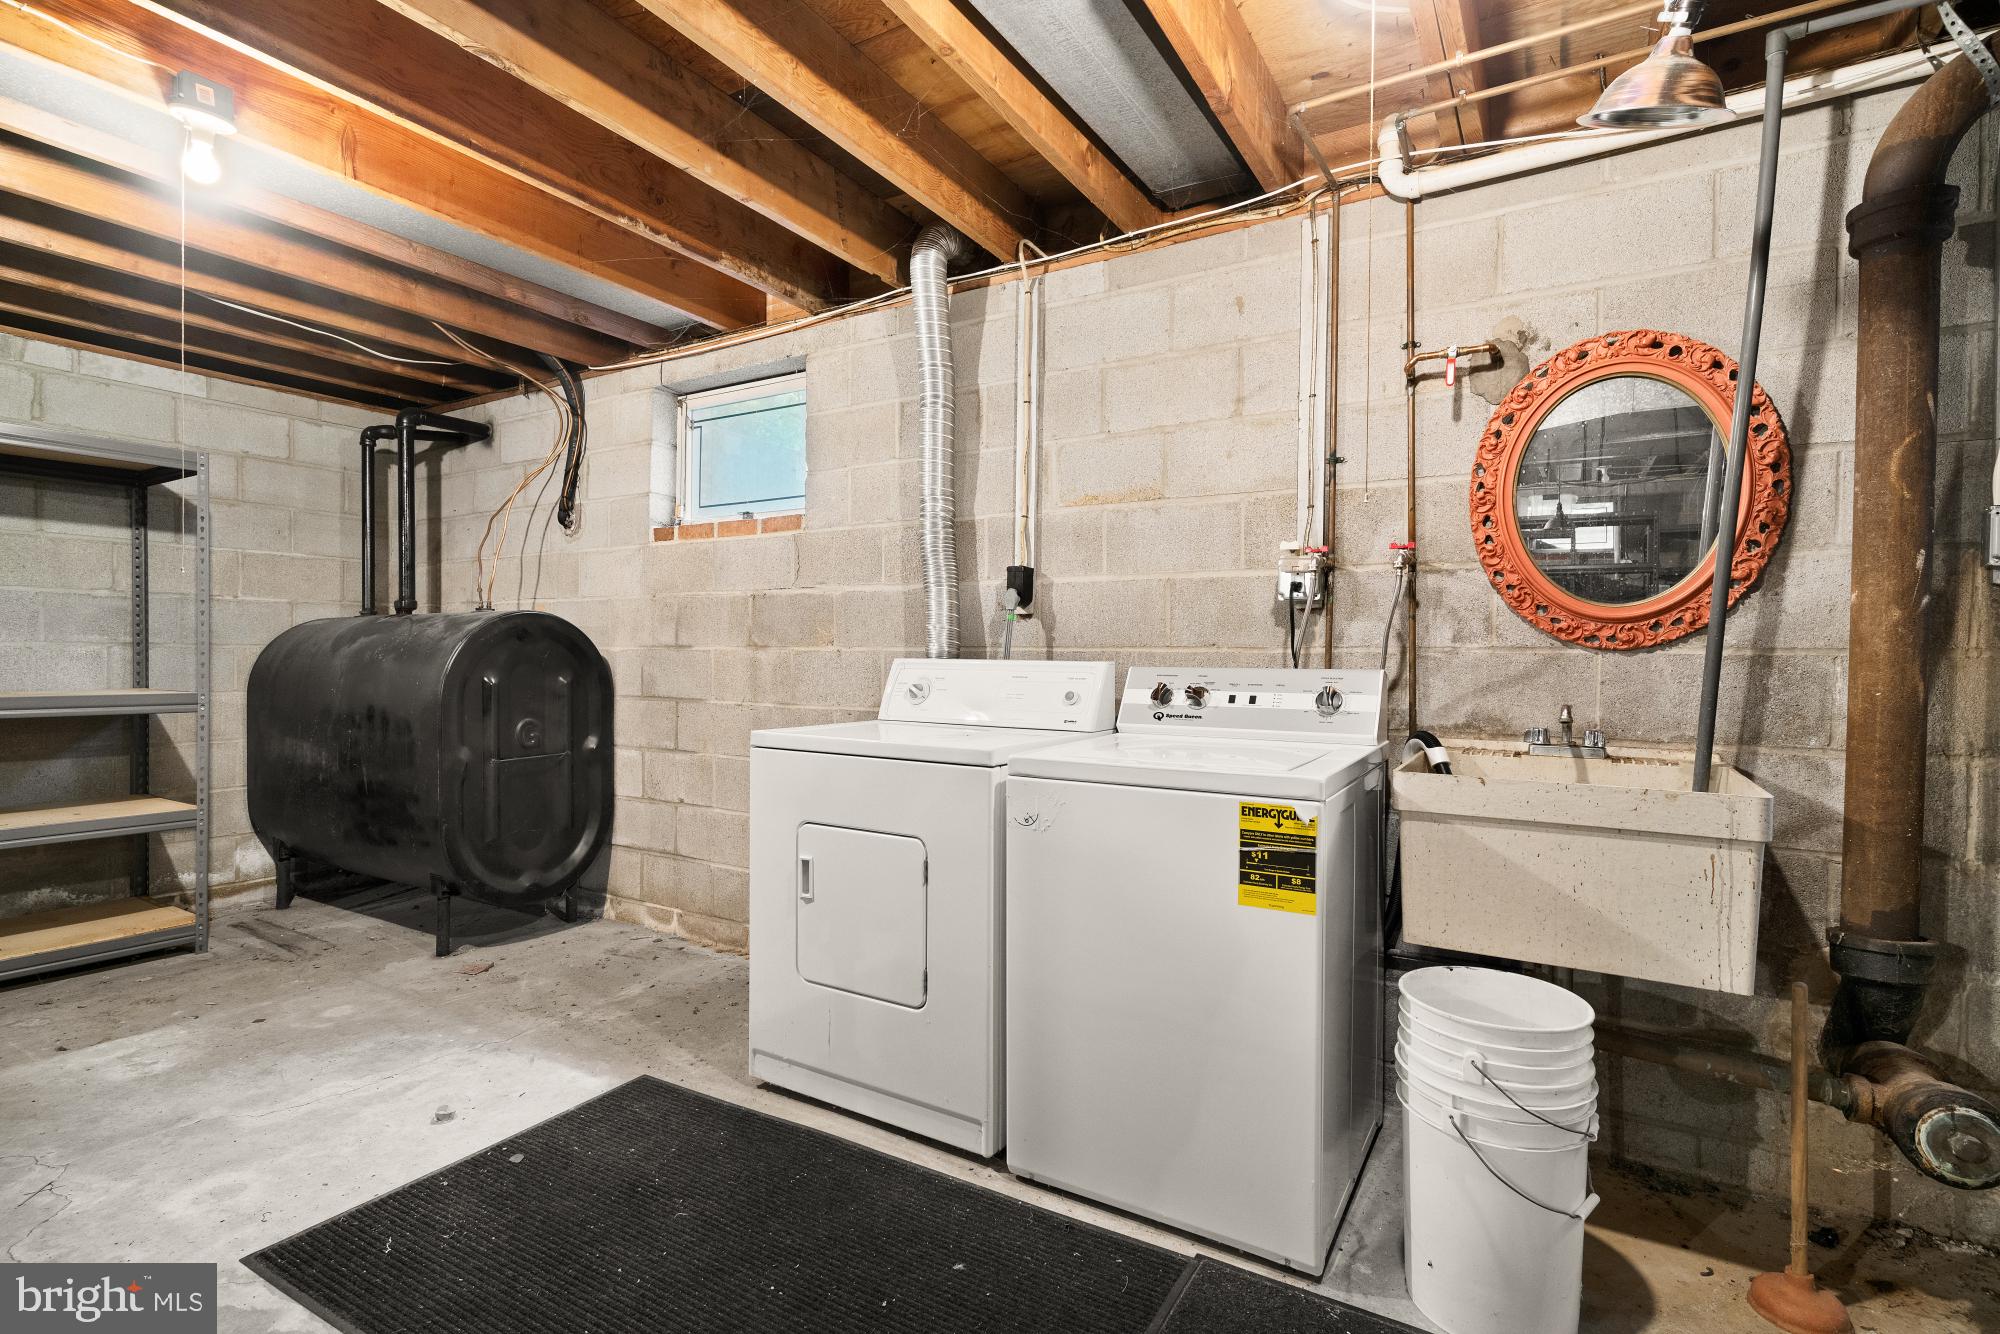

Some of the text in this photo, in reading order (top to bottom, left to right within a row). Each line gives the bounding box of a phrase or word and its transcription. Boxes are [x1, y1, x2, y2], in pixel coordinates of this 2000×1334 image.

[1241, 805, 1315, 823] ENERGYGU
[1251, 851, 1268, 860] $11
[1250, 873, 1260, 881] 82
